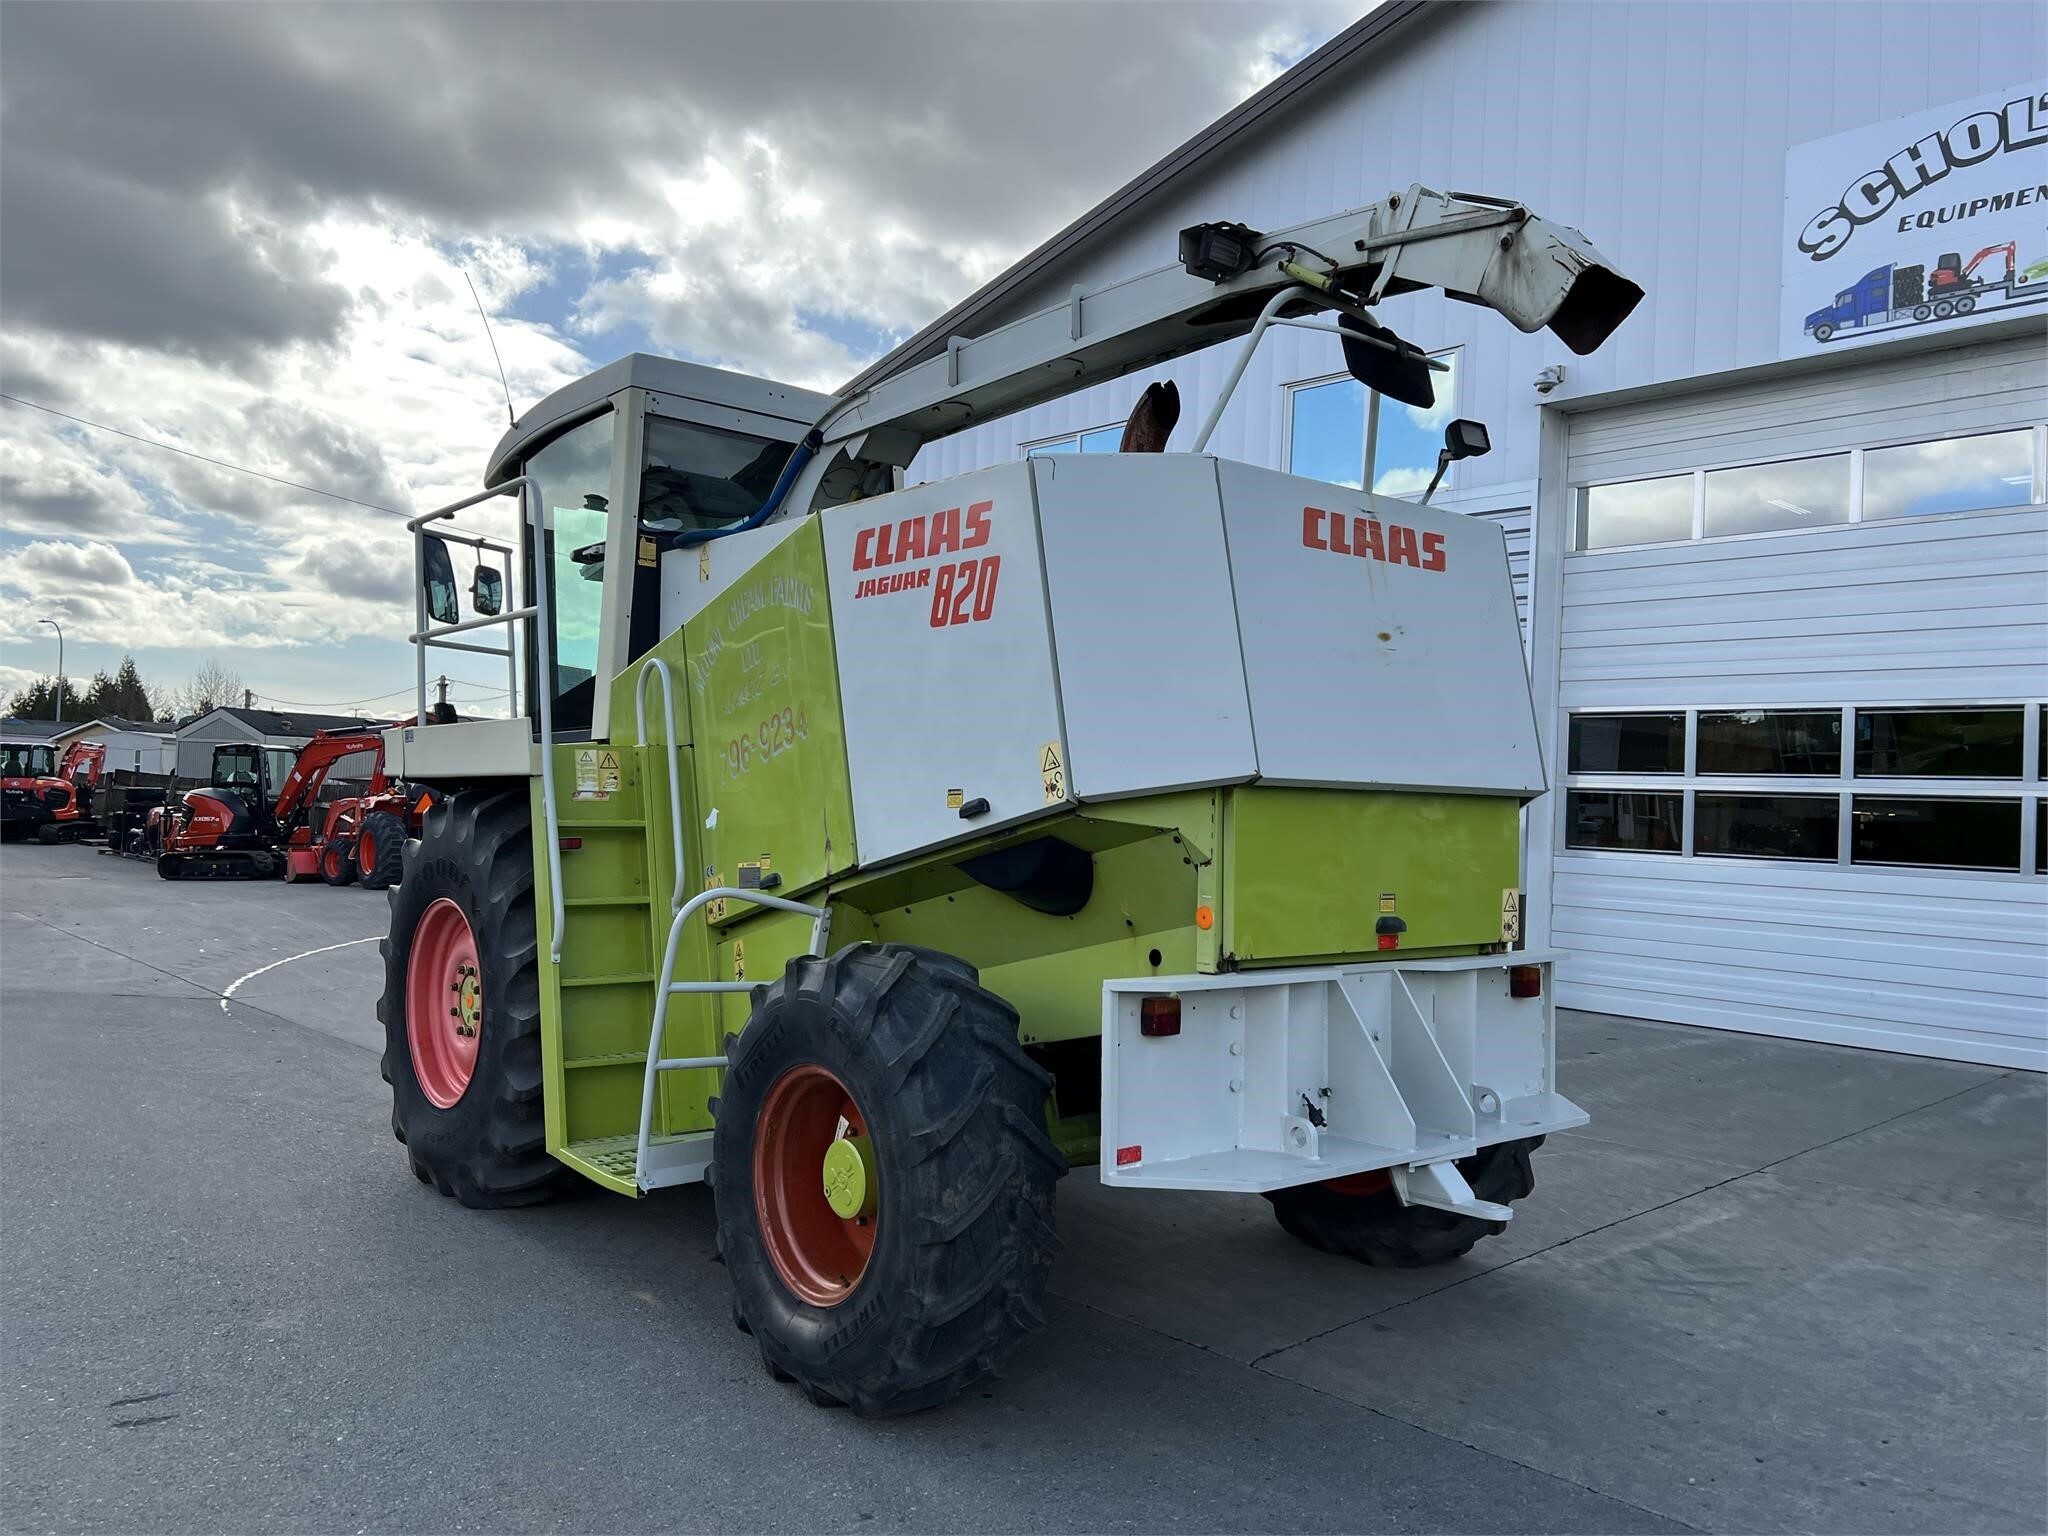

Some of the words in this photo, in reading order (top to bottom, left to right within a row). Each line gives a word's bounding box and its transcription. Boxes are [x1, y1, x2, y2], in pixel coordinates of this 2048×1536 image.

[1797, 92, 2048, 262] SCHOL
[852, 500, 993, 571] CLAAS
[1302, 506, 1446, 572] CLAAS
[854, 568, 931, 599] JAGUAR
[929, 555, 1001, 628] 820
